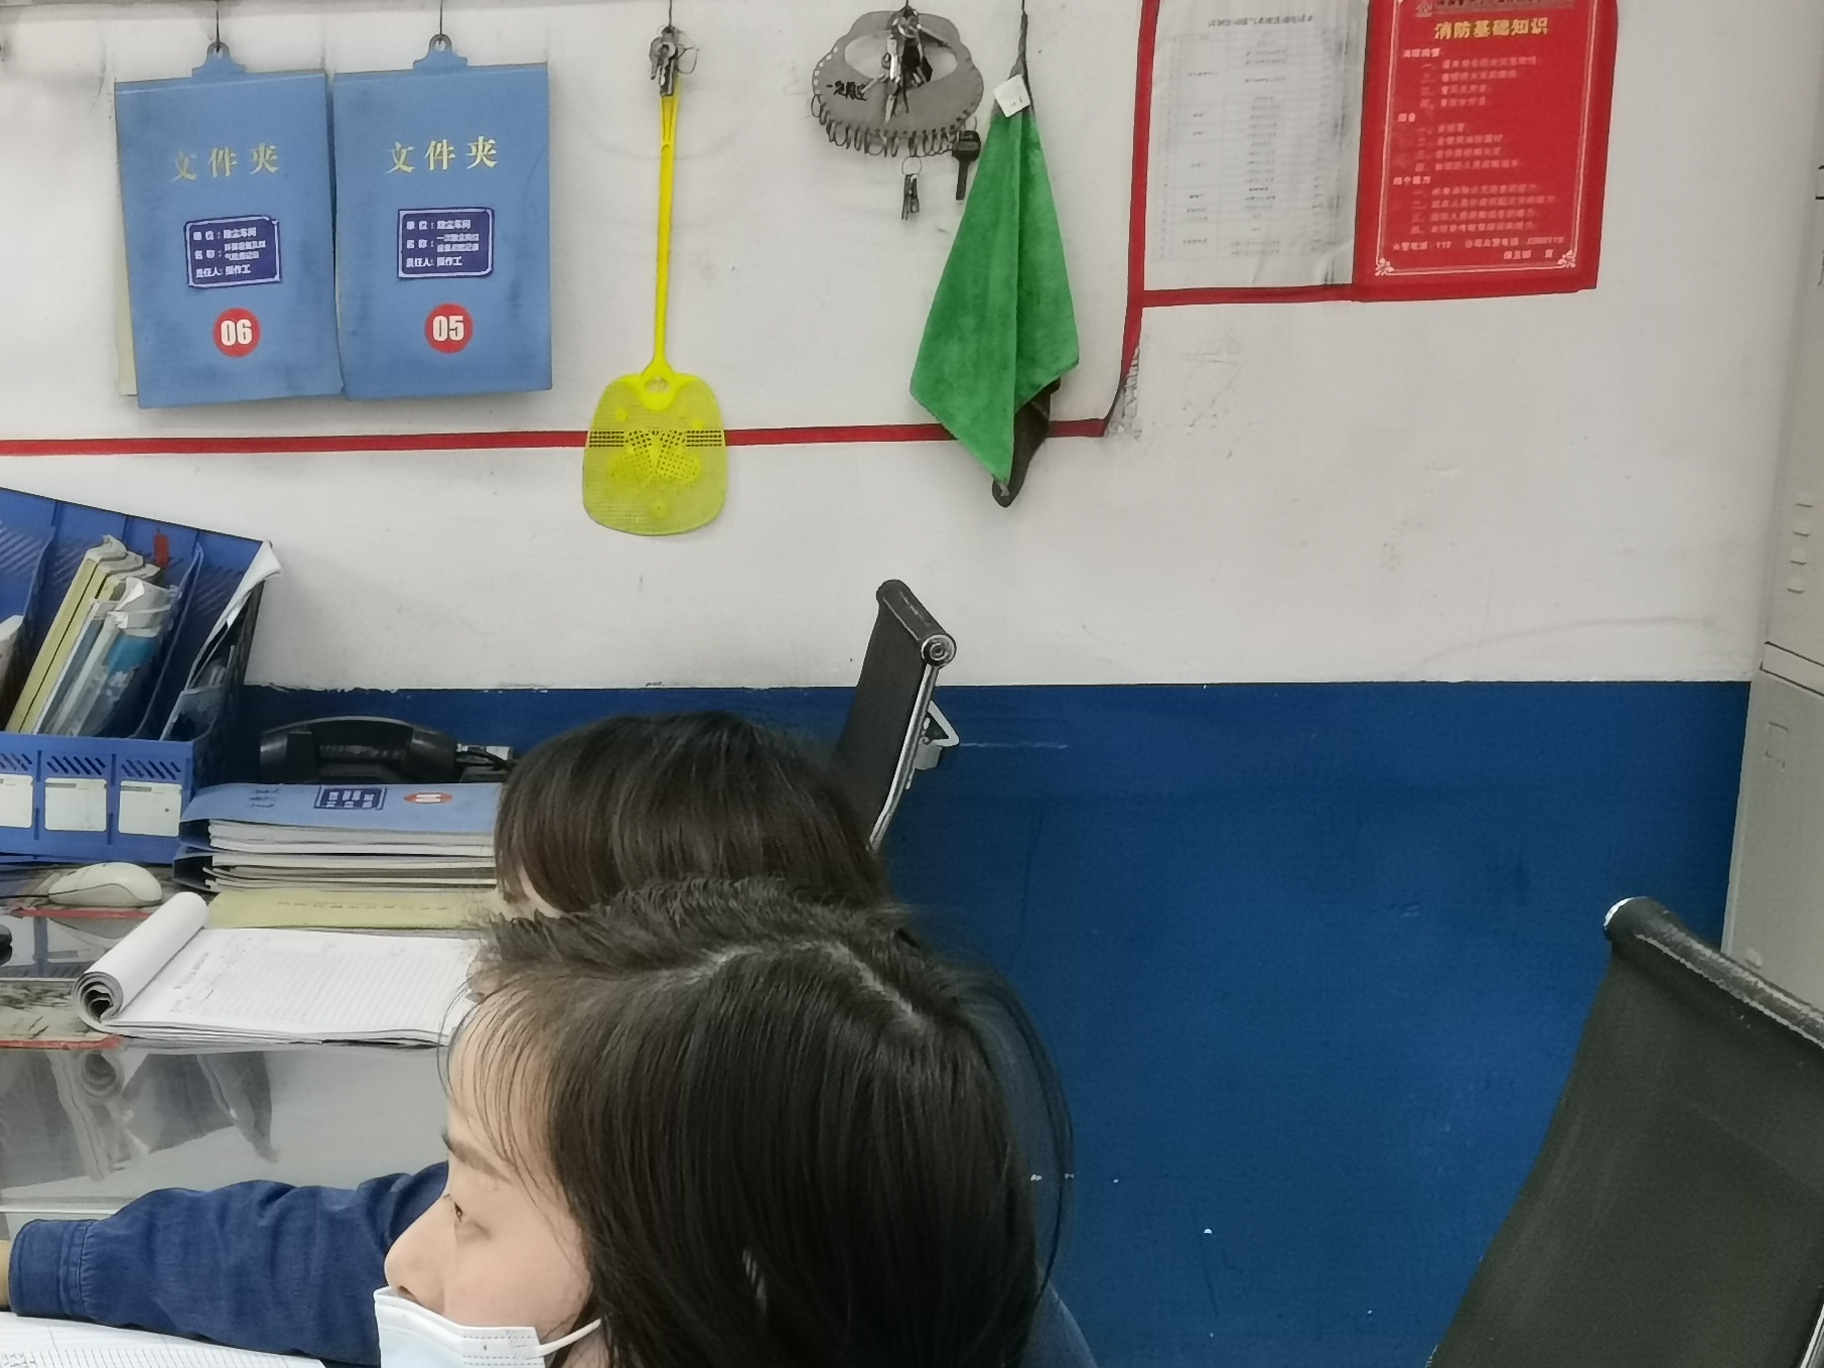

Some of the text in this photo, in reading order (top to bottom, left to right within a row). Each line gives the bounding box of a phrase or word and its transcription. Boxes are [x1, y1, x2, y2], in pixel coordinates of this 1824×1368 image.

[1434, 17, 1548, 40] 消防基础知识
[170, 141, 280, 184] 文件夹
[383, 135, 498, 176] 文件夹
[220, 318, 254, 347] 06
[431, 314, 465, 342] 05
